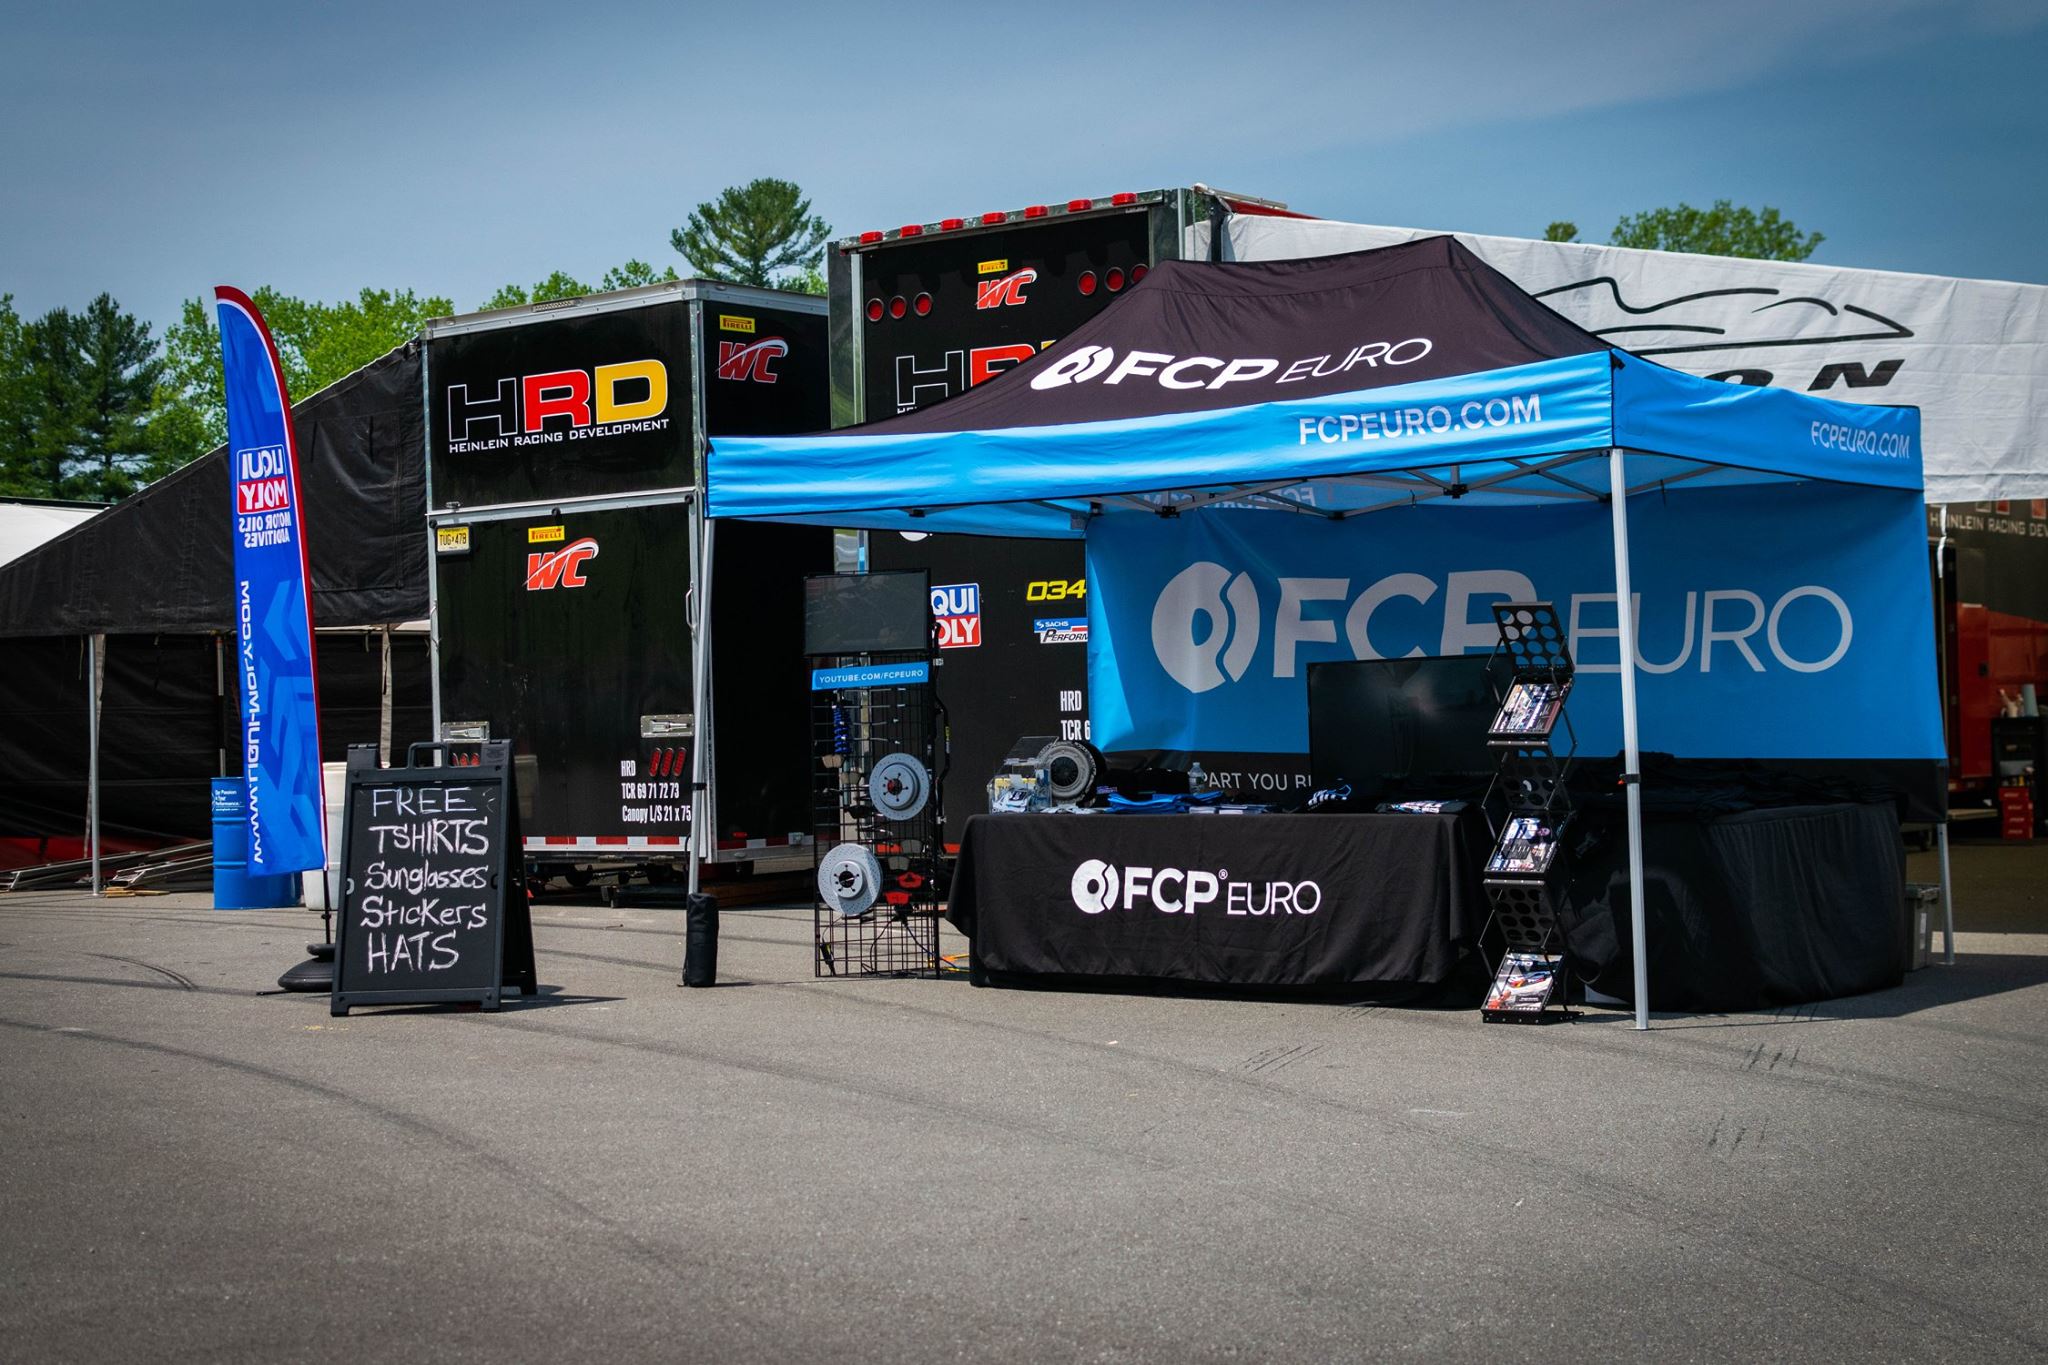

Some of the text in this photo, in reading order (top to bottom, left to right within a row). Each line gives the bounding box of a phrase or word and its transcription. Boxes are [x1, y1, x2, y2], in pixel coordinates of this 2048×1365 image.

[977, 275, 1033, 309] WC
[723, 318, 752, 330] PIRELLI
[719, 341, 783, 383] WC
[1103, 338, 1433, 390] FCP EURO
[448, 359, 668, 442] HRD
[1300, 394, 1542, 445] FCPEURO.COM
[449, 419, 669, 454] HEINLEIN RACING DEVELOPMENT
[1811, 421, 1910, 459] FCPEURO.COM
[532, 528, 561, 540] PIRELLI
[1930, 512, 1984, 531] HINLEIN
[1988, 518, 2026, 535] RACING
[527, 549, 594, 590] WC
[1026, 579, 1087, 601] 034
[1045, 620, 1069, 628] SACHS
[1273, 571, 1853, 678] FCP EURO
[819, 669, 924, 683] YOUTUBE.COM/FCPEURO
[1060, 690, 1082, 711] HRD
[1061, 719, 1082, 741] TCR
[621, 760, 636, 777] HRD
[1248, 773, 1288, 791] YOU
[373, 787, 477, 817] FREE
[621, 783, 636, 799] TCR
[648, 783, 658, 799] 71
[659, 783, 669, 799] 72
[670, 783, 680, 799] 73
[622, 805, 649, 824] Canopy
[664, 805, 673, 821] 21
[368, 816, 489, 856] TSHIRTS
[364, 859, 488, 895] Sunglasses
[1227, 880, 1321, 915] EURO
[368, 929, 459, 973] HATS
